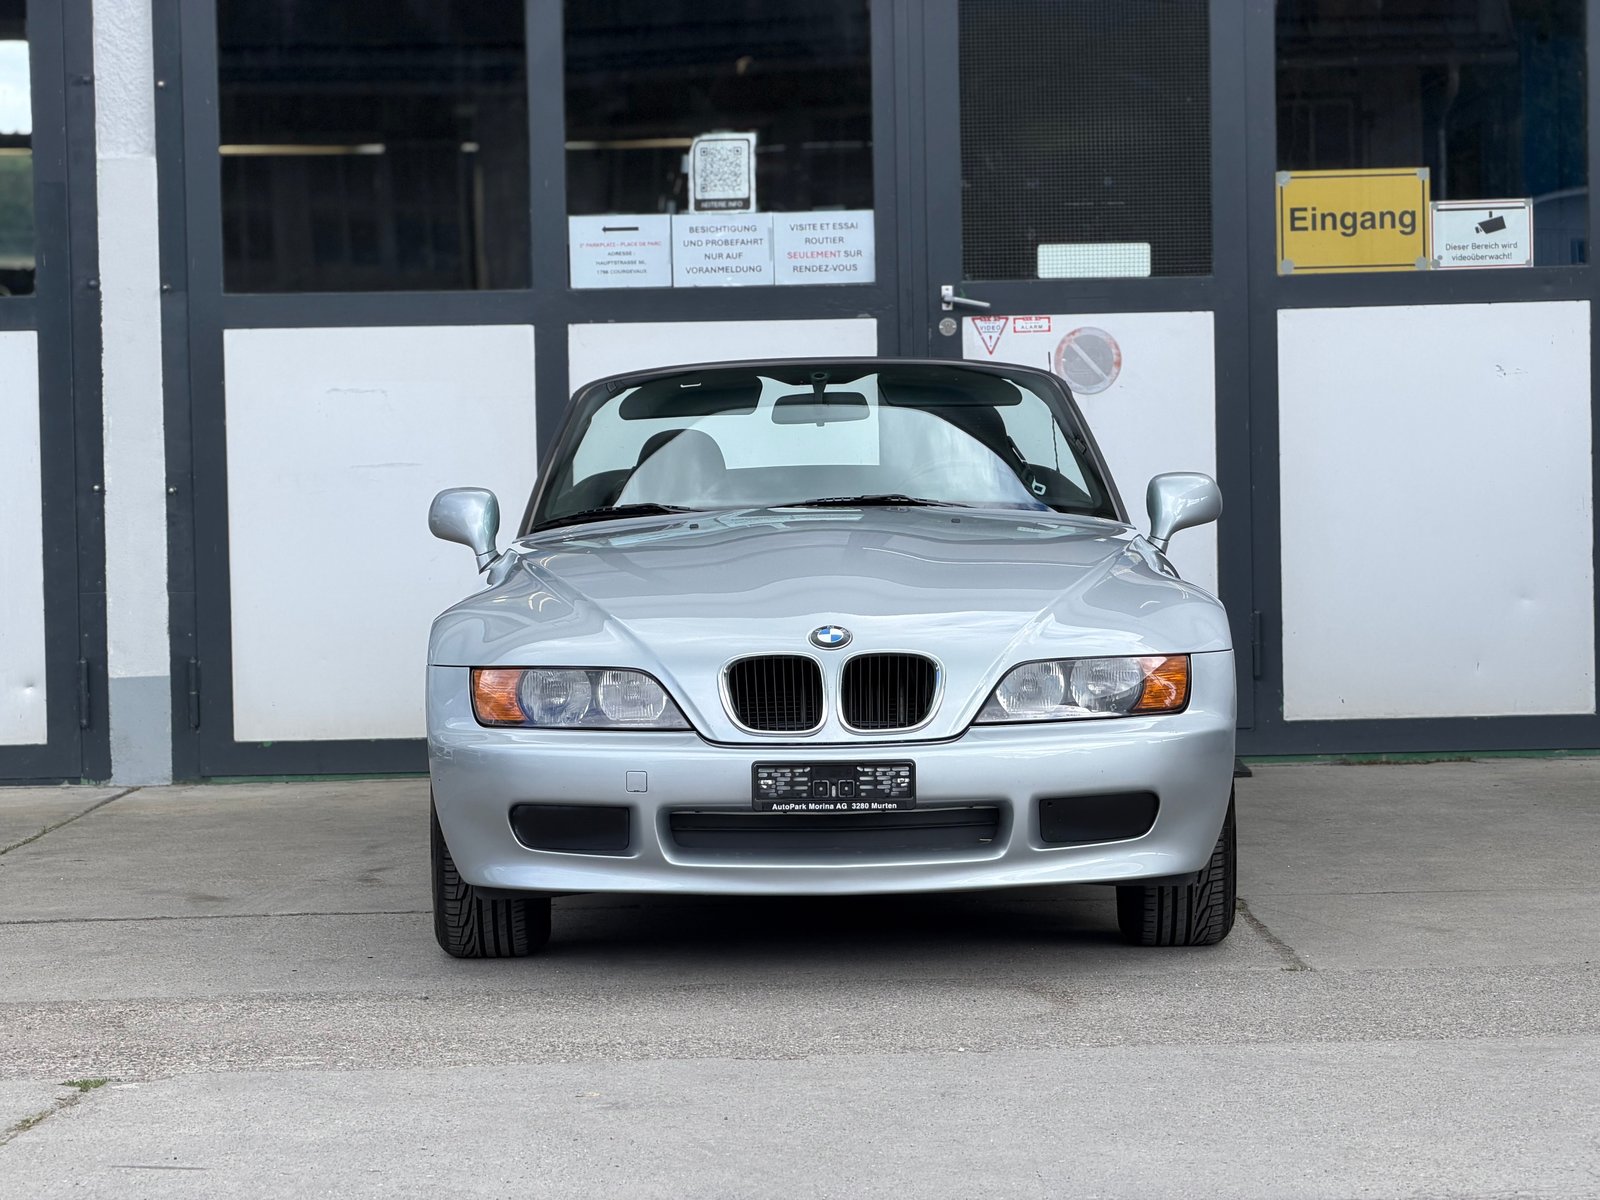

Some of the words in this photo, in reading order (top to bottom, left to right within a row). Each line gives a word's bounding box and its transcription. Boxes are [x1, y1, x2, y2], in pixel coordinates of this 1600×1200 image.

[1290, 206, 1416, 237] Eingang
[689, 225, 757, 234] BESICHTIGUNG
[790, 223, 818, 231] VISITE
[706, 238, 764, 247] PROBEFAHRT
[804, 236, 844, 244] ROUTIER
[1446, 243, 1469, 251] Dieser
[1472, 242, 1499, 250] Bereich
[787, 250, 842, 259] SEULEMENT
[1452, 252, 1512, 261] videoüberwacht!
[686, 265, 762, 274] VORANMELDUNG
[792, 264, 858, 273] RENDEZ-VOUS
